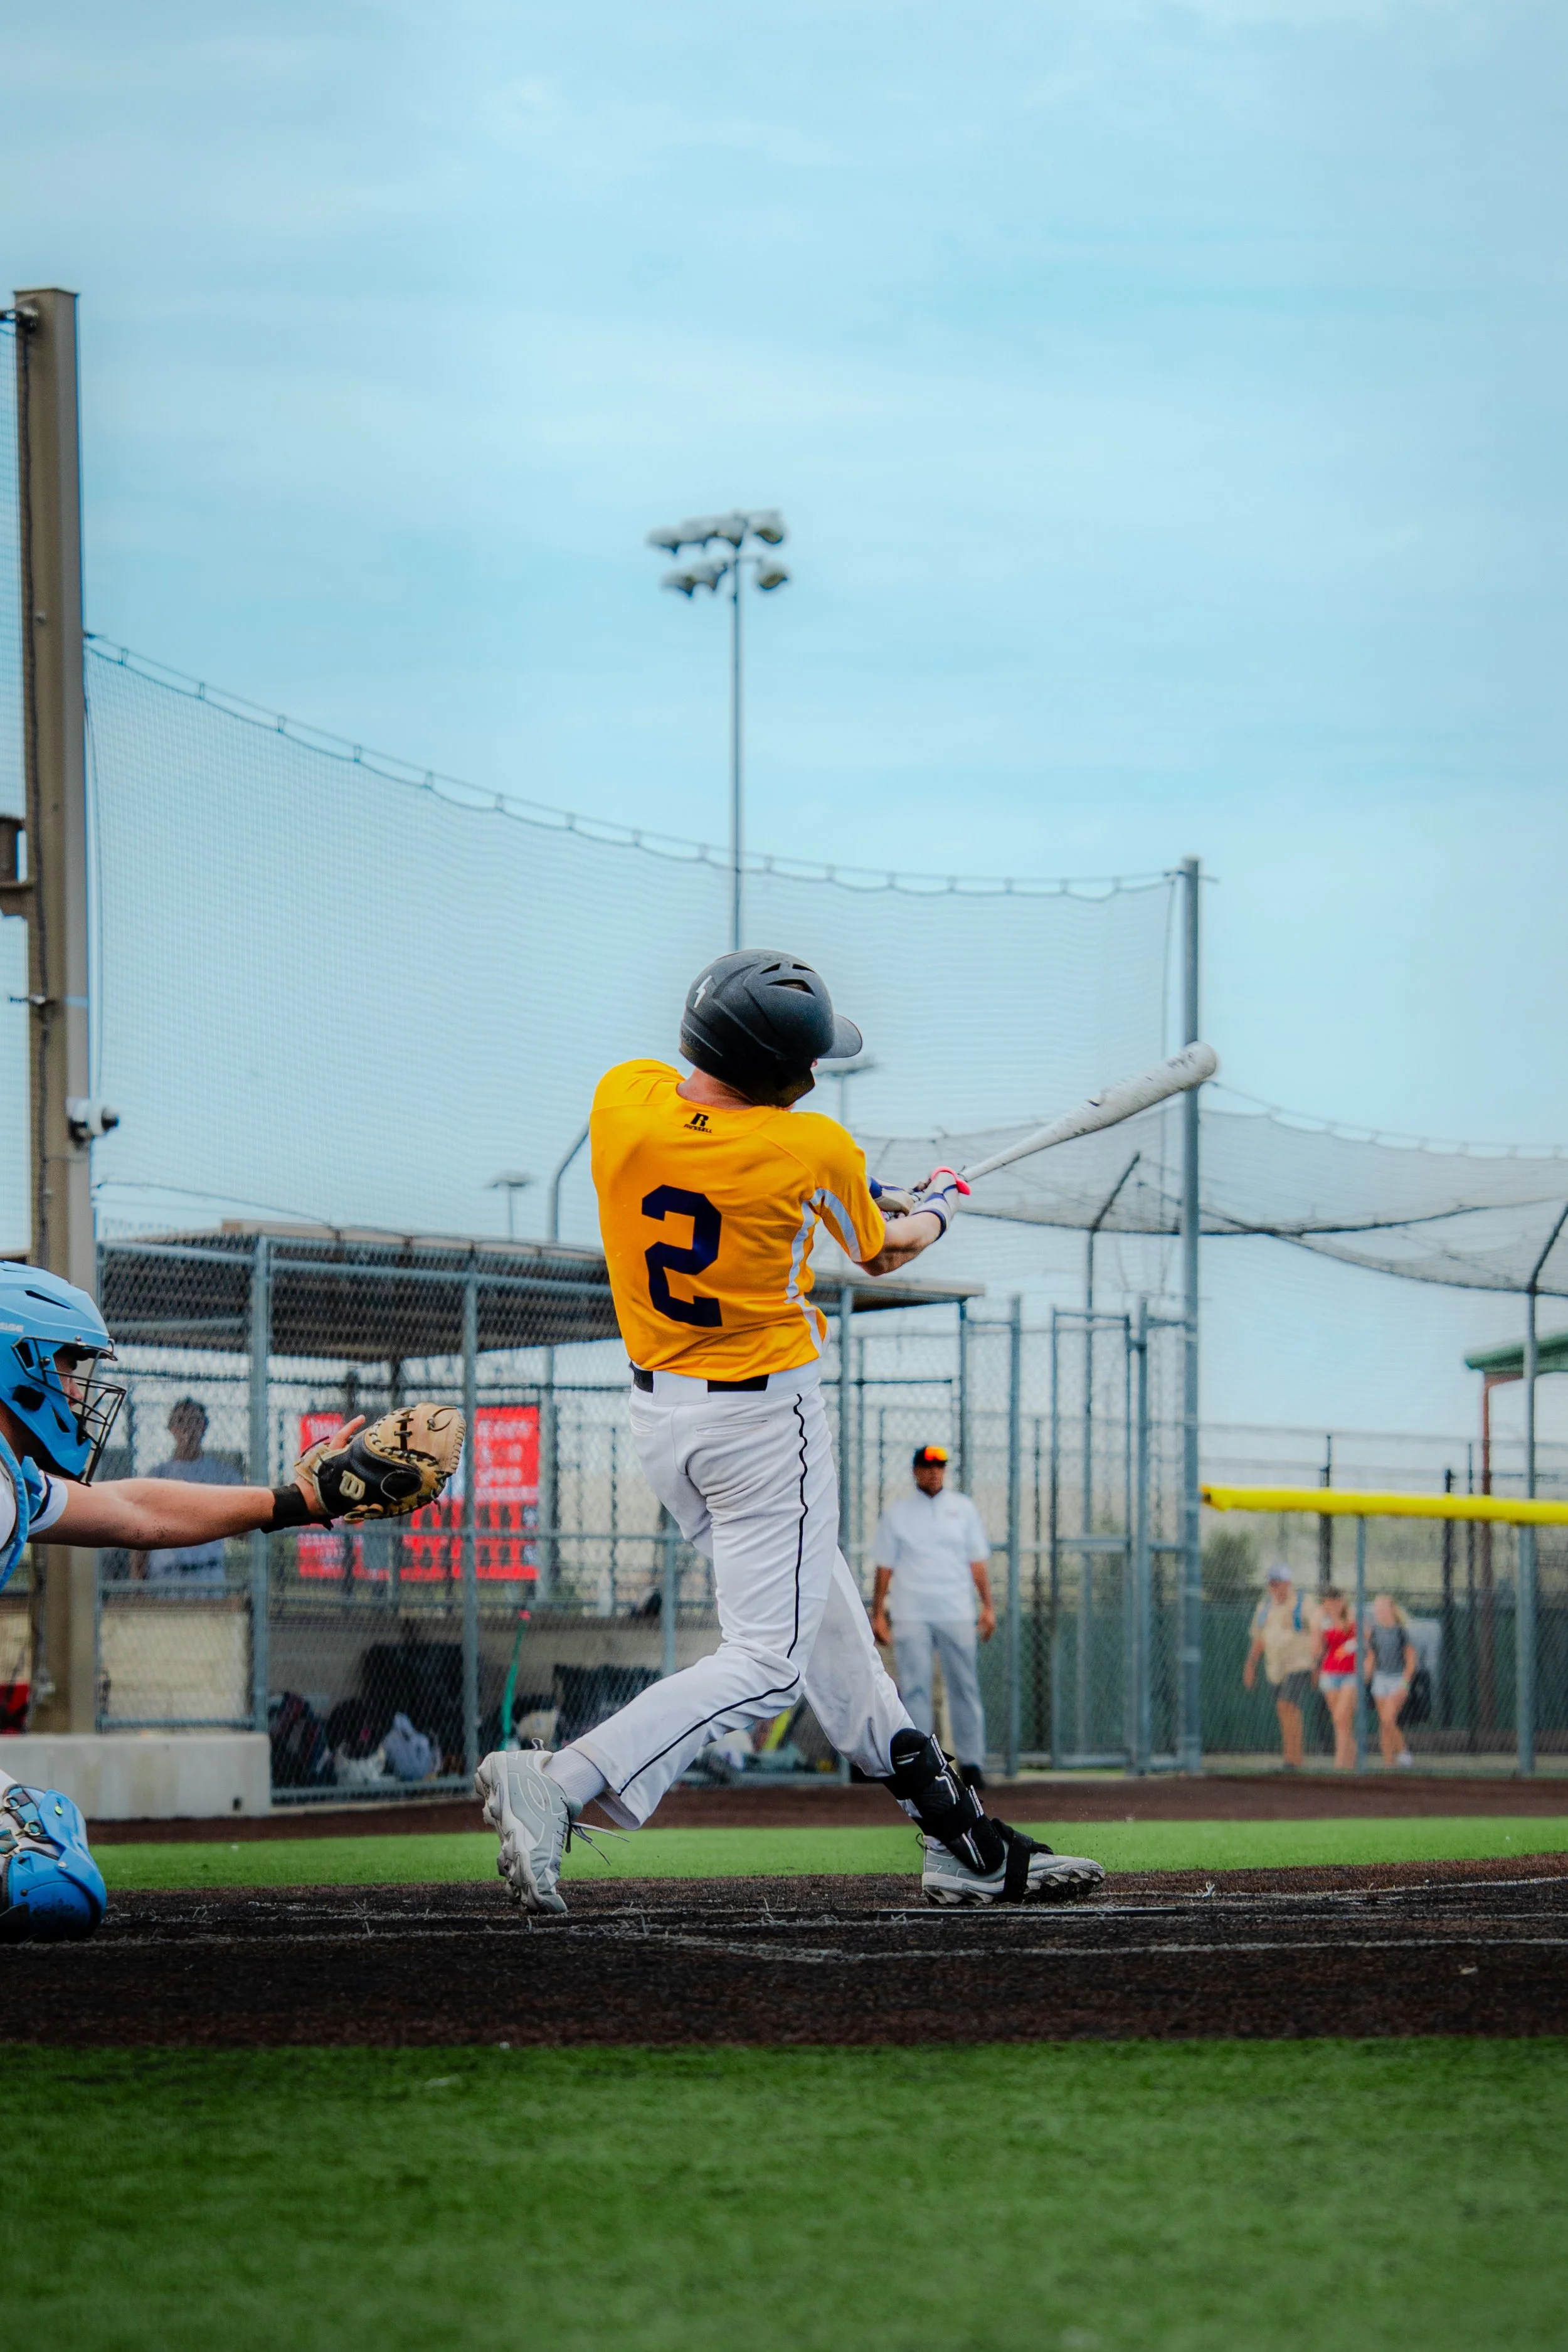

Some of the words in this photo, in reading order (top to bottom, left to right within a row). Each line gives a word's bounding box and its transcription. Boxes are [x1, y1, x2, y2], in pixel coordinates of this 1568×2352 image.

[691, 1113, 709, 1126] R
[684, 1123, 712, 1133] RUSSELL
[641, 1184, 723, 1327] 2
